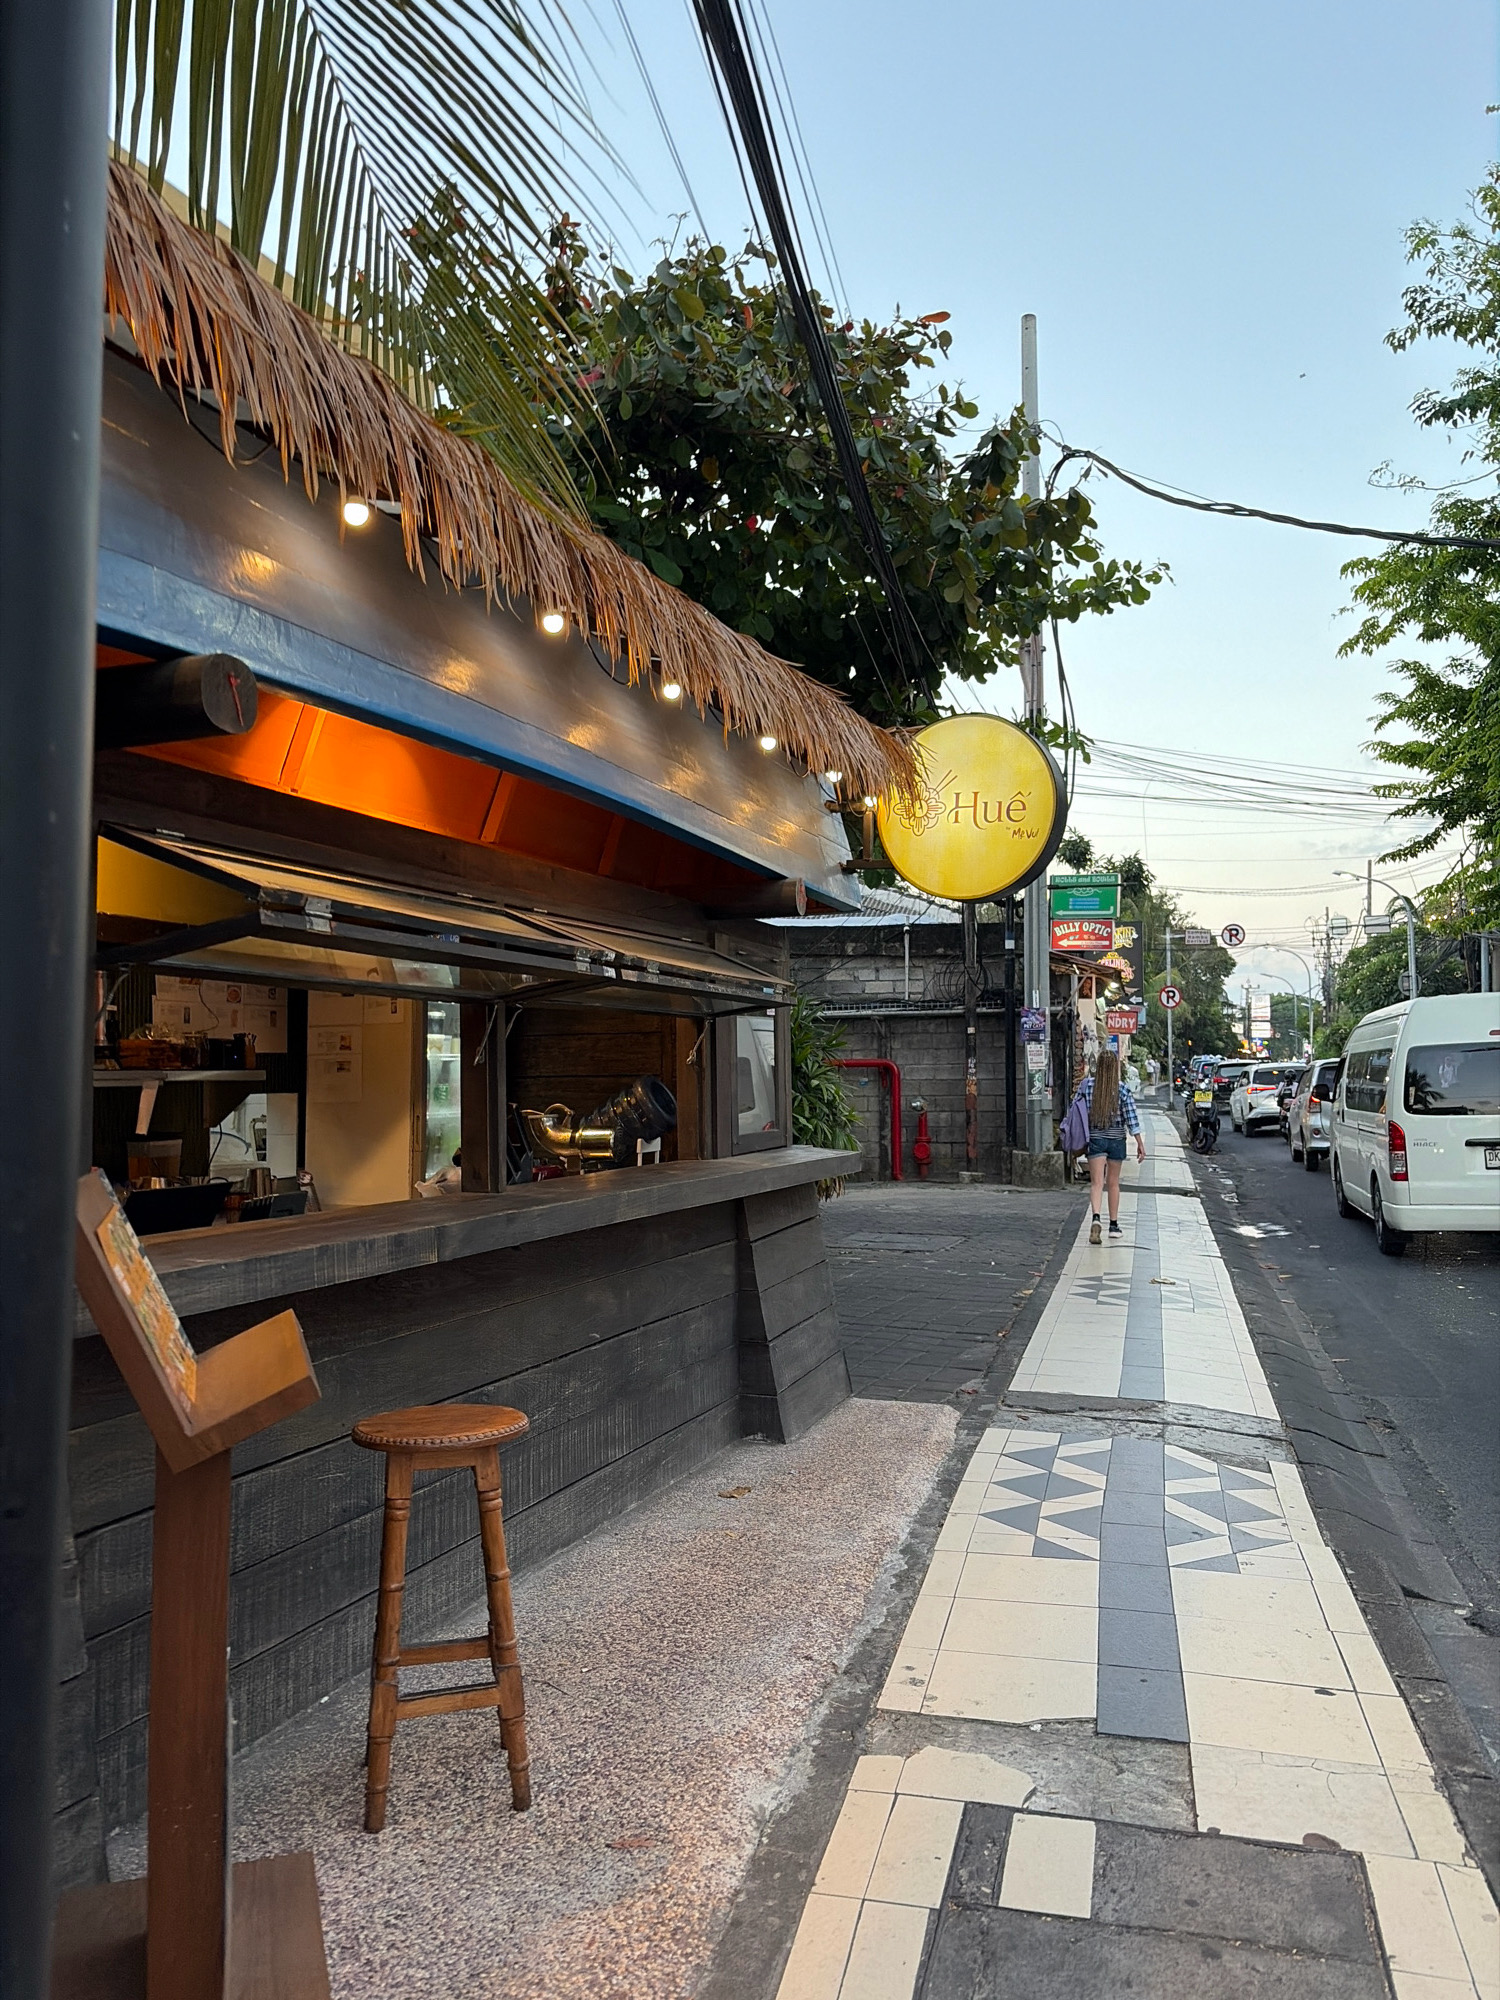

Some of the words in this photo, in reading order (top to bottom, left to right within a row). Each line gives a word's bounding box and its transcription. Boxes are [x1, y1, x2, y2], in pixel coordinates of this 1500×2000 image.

[1053, 922, 1081, 937] BILLY
[1082, 922, 1111, 937] OPTIC
[1107, 1017, 1136, 1029] NDRY
